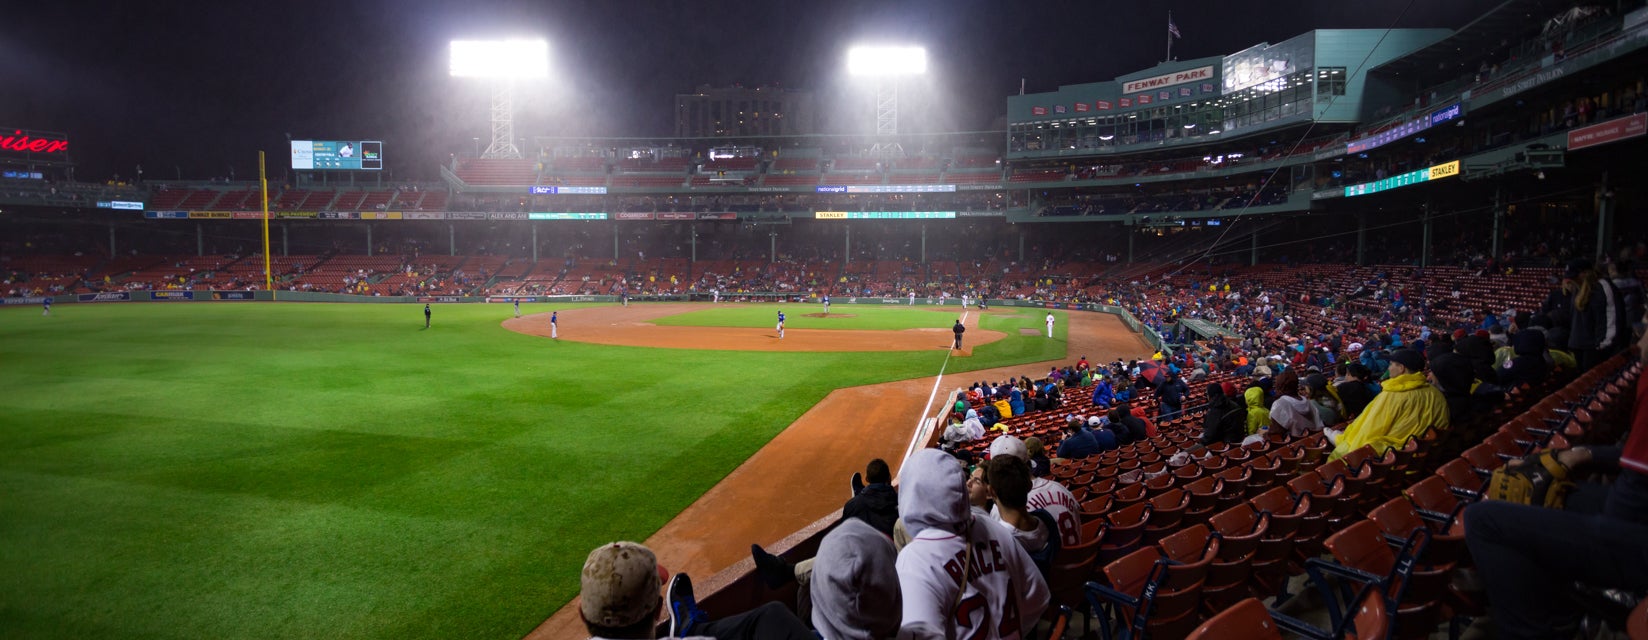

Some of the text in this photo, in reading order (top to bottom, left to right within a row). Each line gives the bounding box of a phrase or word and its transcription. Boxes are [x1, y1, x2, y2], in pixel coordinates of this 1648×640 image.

[1127, 69, 1207, 91] FENWAY PARK
[1432, 164, 1456, 178] STANLEY
[1026, 491, 1075, 513] HILLING
[944, 539, 1006, 588] PRICE
[1144, 583, 1156, 598] KK
